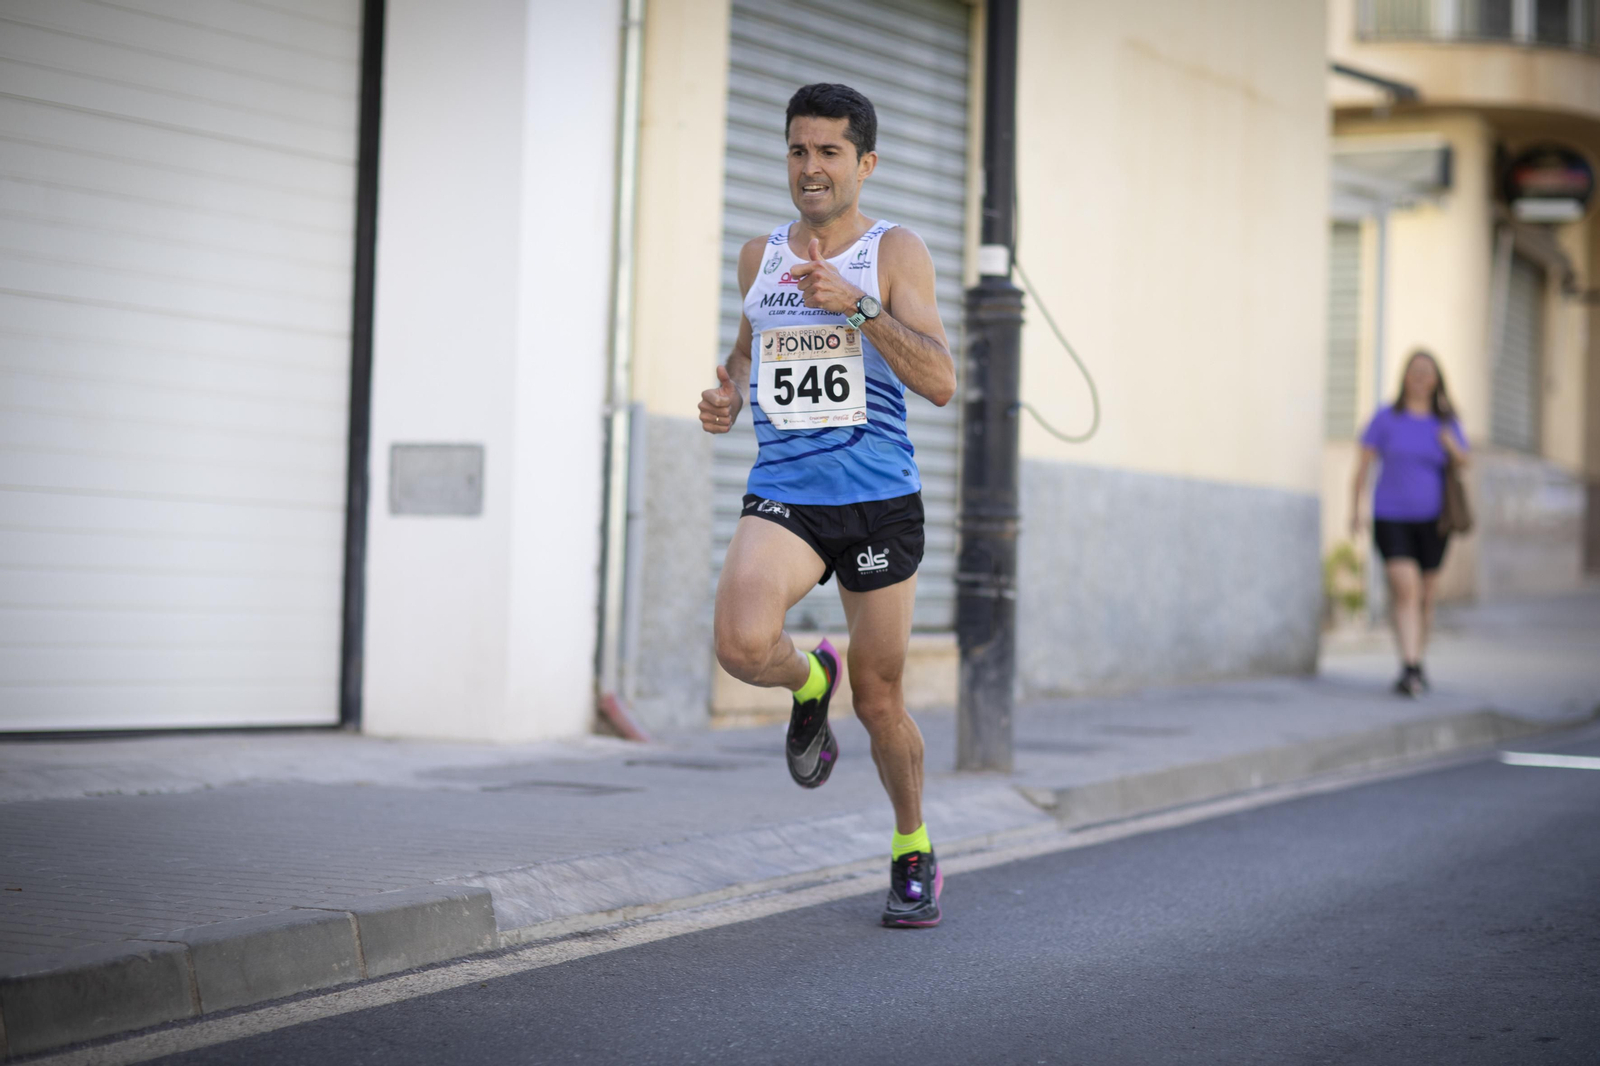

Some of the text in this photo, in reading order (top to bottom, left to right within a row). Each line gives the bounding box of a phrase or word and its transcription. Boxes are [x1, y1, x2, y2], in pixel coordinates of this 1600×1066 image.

[779, 334, 841, 353] FONDO
[799, 329, 827, 337] PREMIO
[773, 364, 850, 406] 546
[857, 545, 889, 571] als
